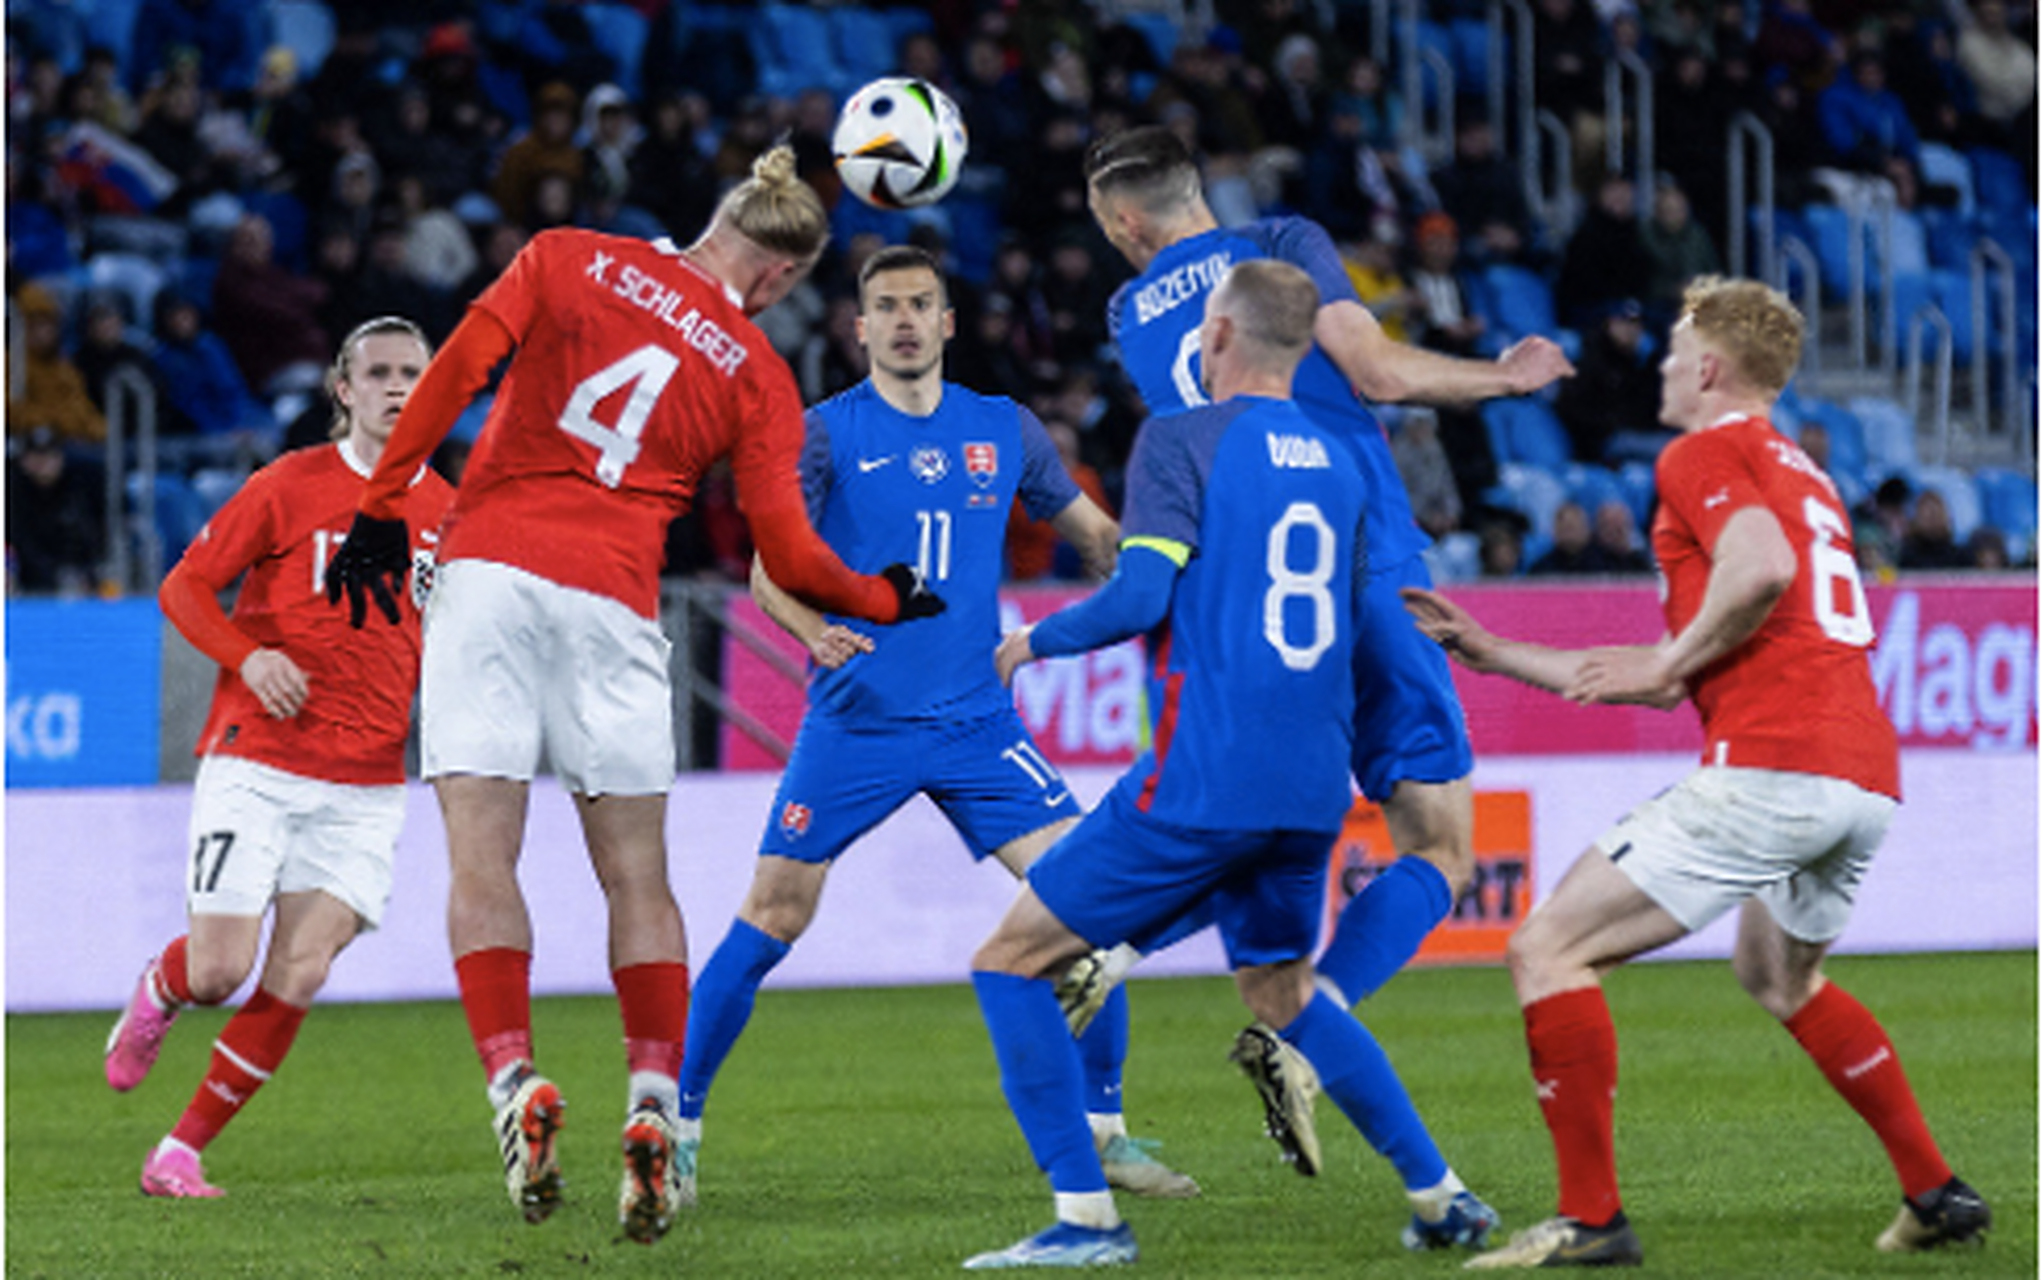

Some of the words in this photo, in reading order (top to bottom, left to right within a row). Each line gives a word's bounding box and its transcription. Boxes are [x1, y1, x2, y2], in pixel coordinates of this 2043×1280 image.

[613, 264, 748, 377] SCHLAGER
[557, 344, 680, 489] 4
[916, 511, 950, 580] 11
[1264, 502, 1336, 671] 8
[1803, 496, 1877, 646] 6
[1001, 741, 1060, 788] 11
[194, 831, 236, 893] 17
